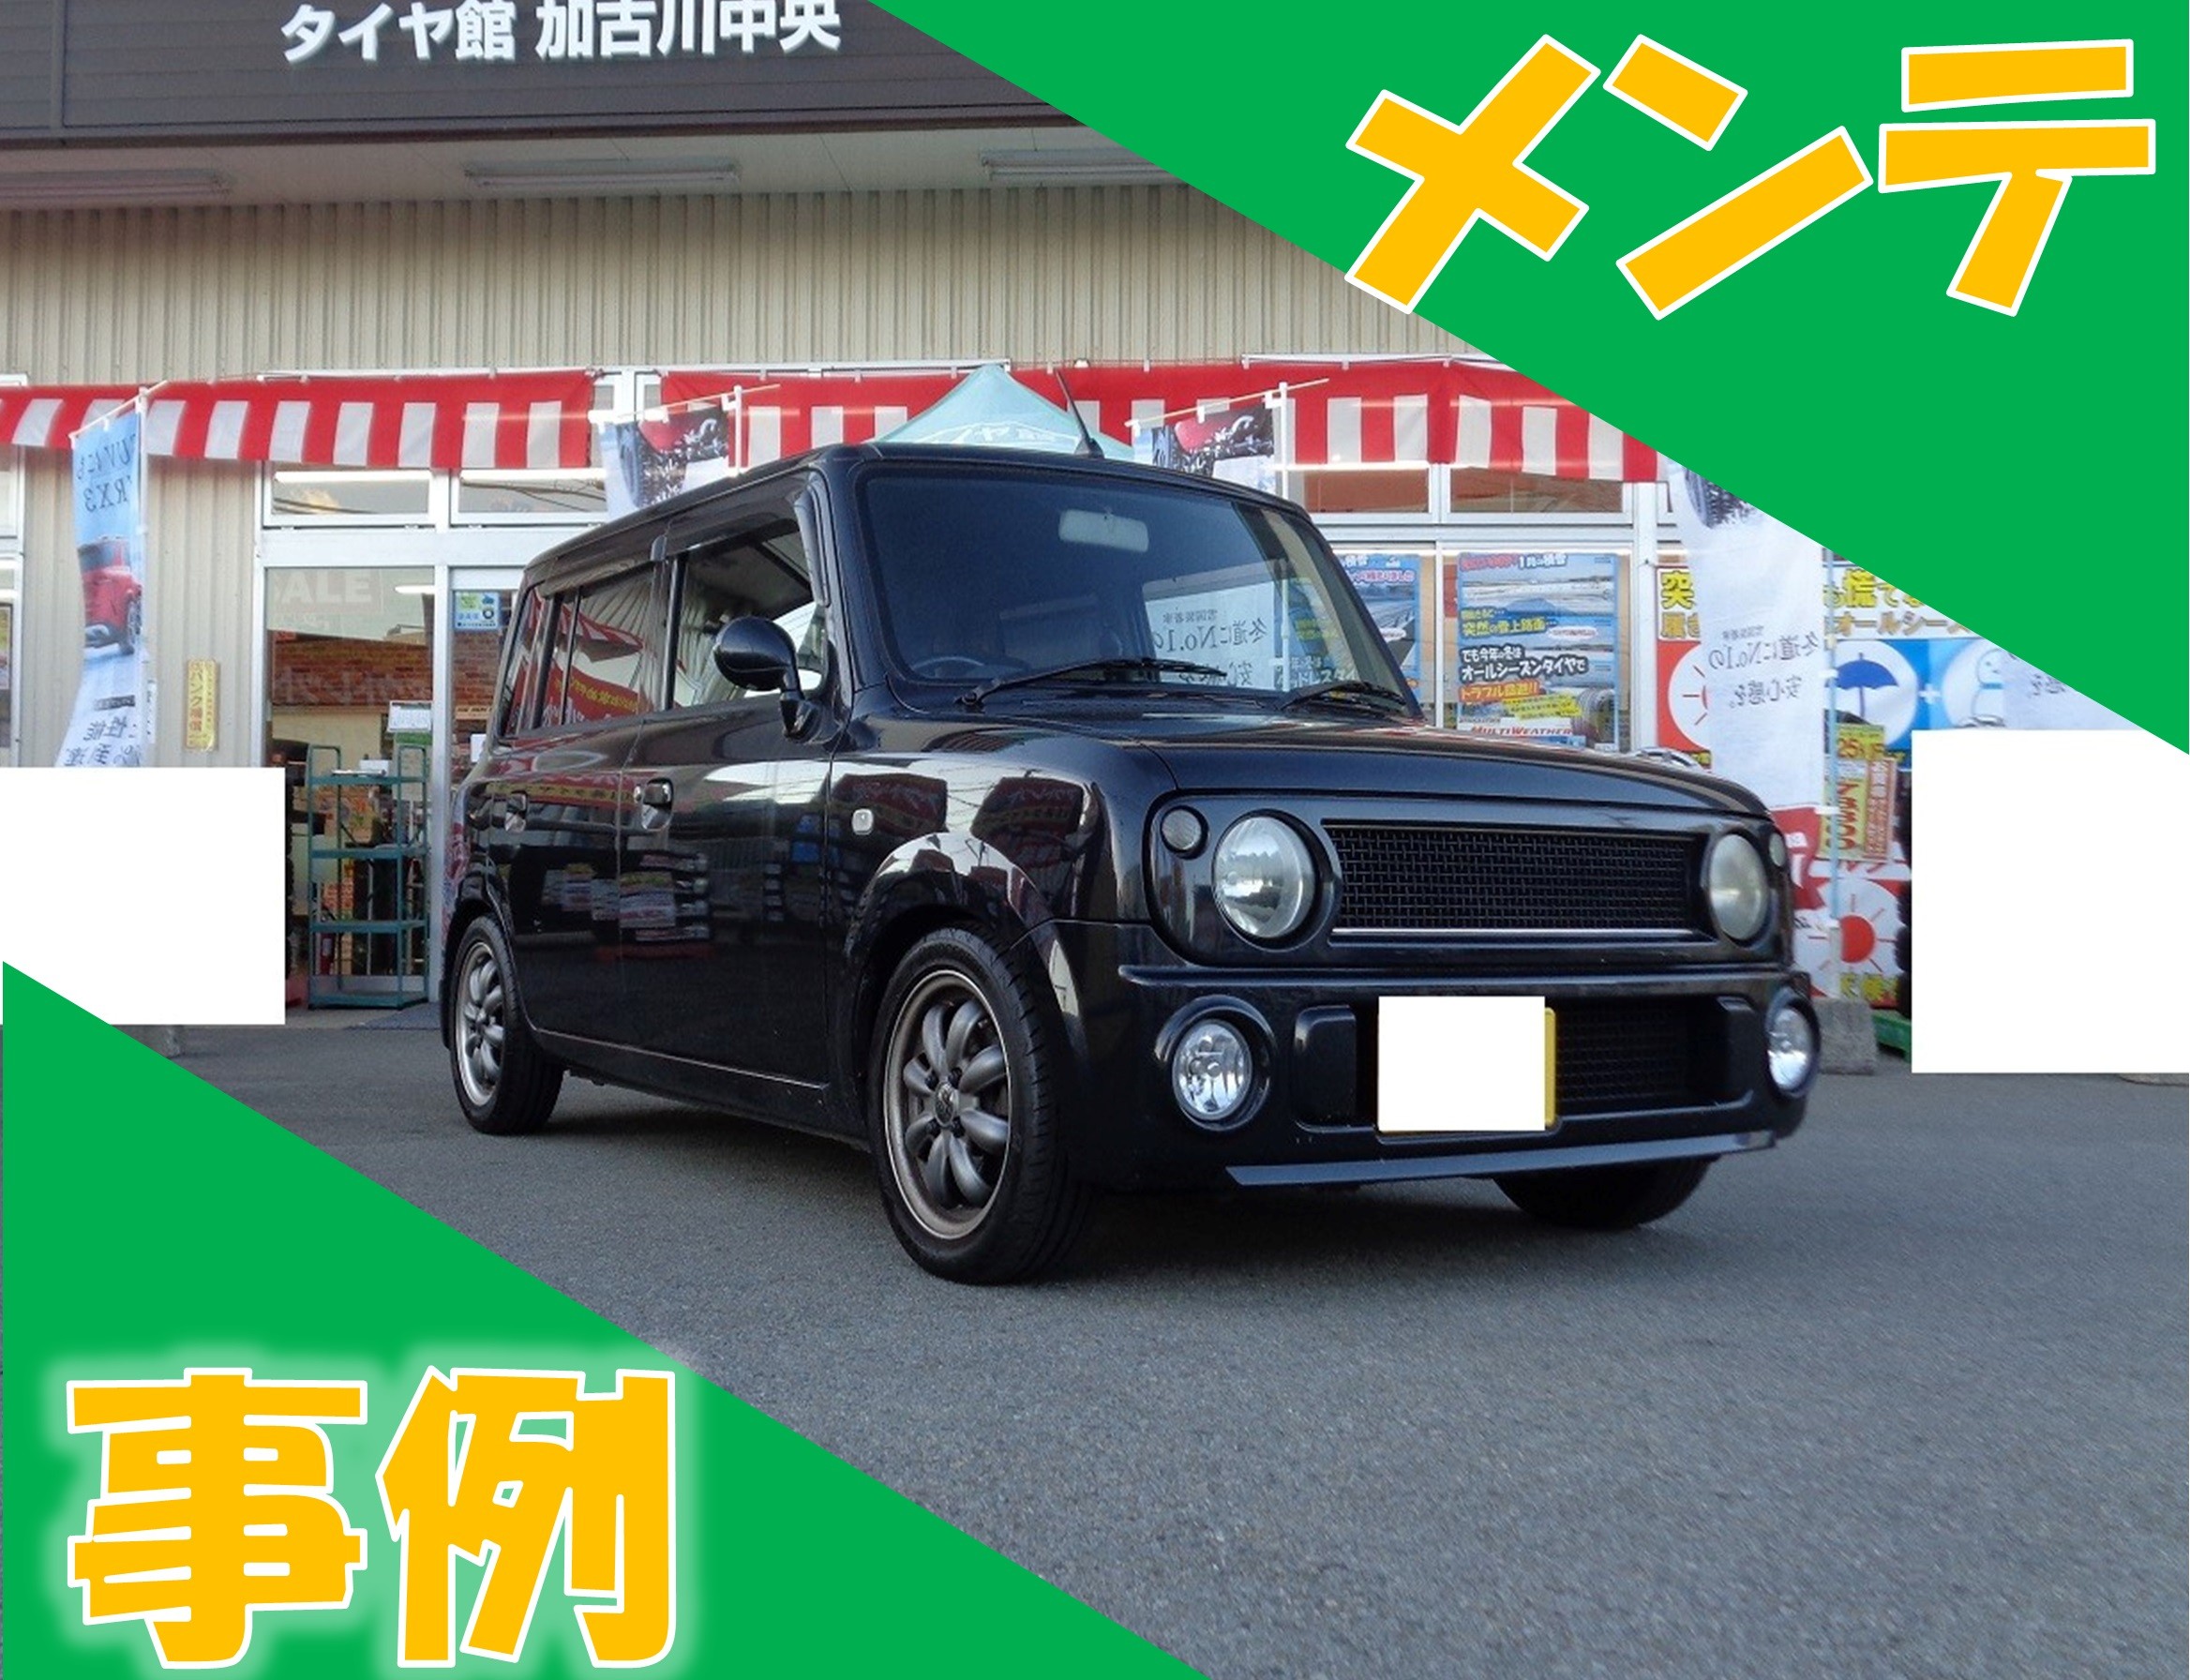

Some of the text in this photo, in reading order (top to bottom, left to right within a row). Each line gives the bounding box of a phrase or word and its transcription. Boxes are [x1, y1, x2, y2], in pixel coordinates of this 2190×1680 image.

[281, 0, 841, 63] タイヤ館 加古川中央
